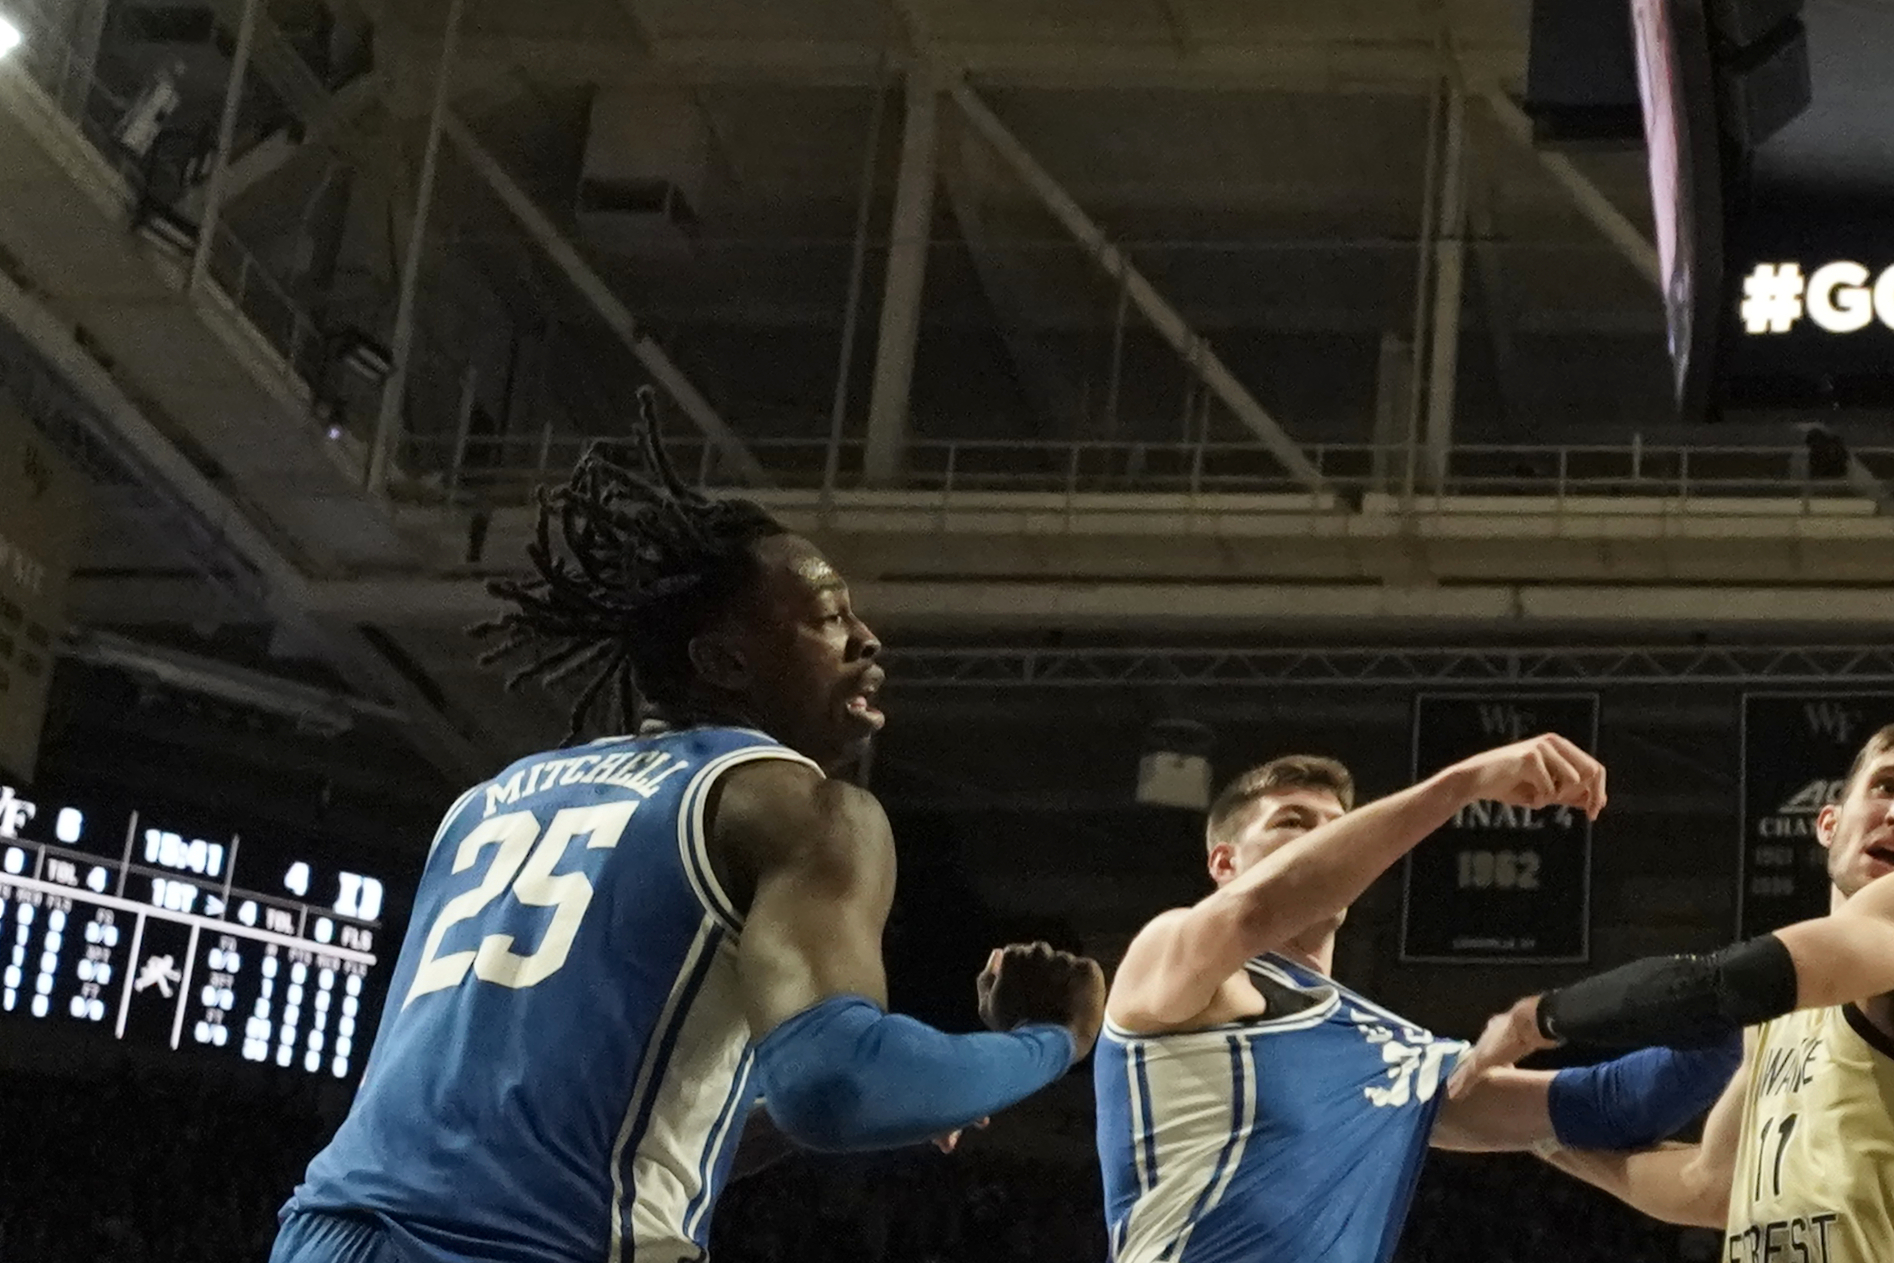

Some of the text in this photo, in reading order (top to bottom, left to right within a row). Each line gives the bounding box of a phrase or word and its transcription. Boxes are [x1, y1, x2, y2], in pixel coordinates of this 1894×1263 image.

[284, 861, 310, 897] 4
[334, 870, 383, 922] D
[401, 800, 640, 1013] 25
[1754, 1112, 1800, 1203] 11
